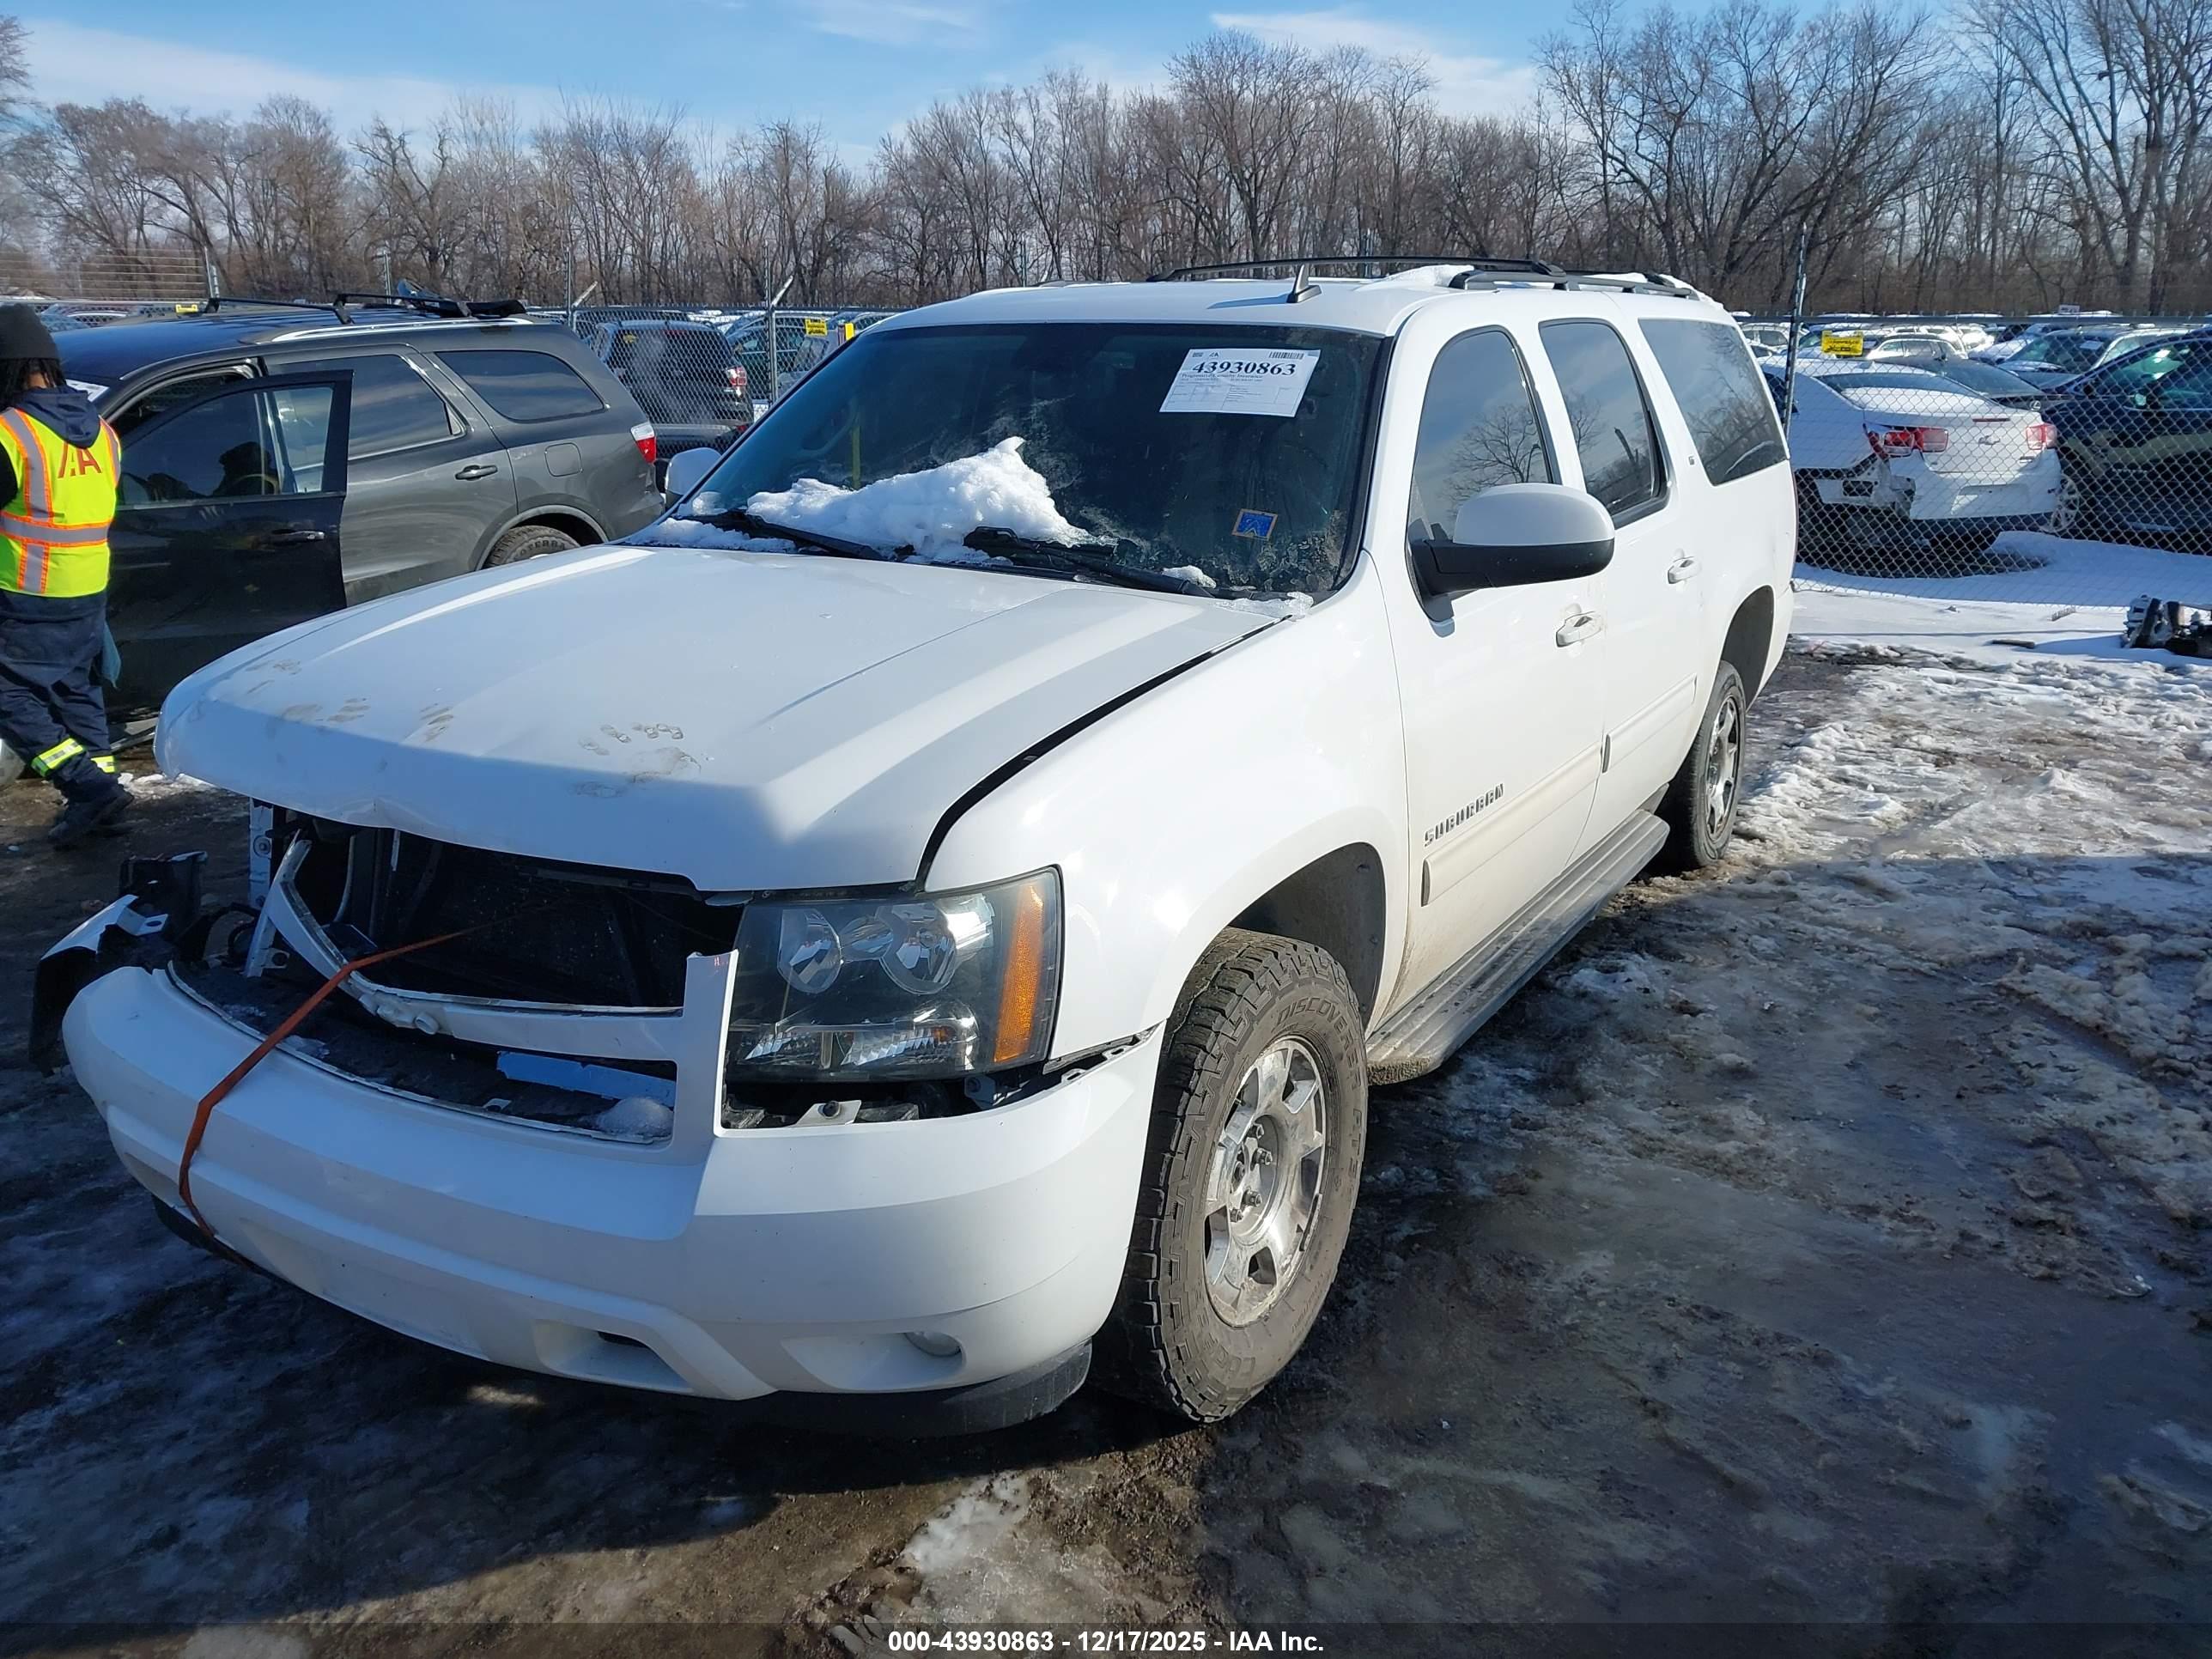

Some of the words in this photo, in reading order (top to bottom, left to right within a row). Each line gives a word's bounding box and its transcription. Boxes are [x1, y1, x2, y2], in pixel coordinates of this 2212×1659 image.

[1193, 361, 1296, 376] 43930863
[1425, 782, 1504, 847] SUBURBAN
[1276, 996, 1362, 1091] DISCOVERER
